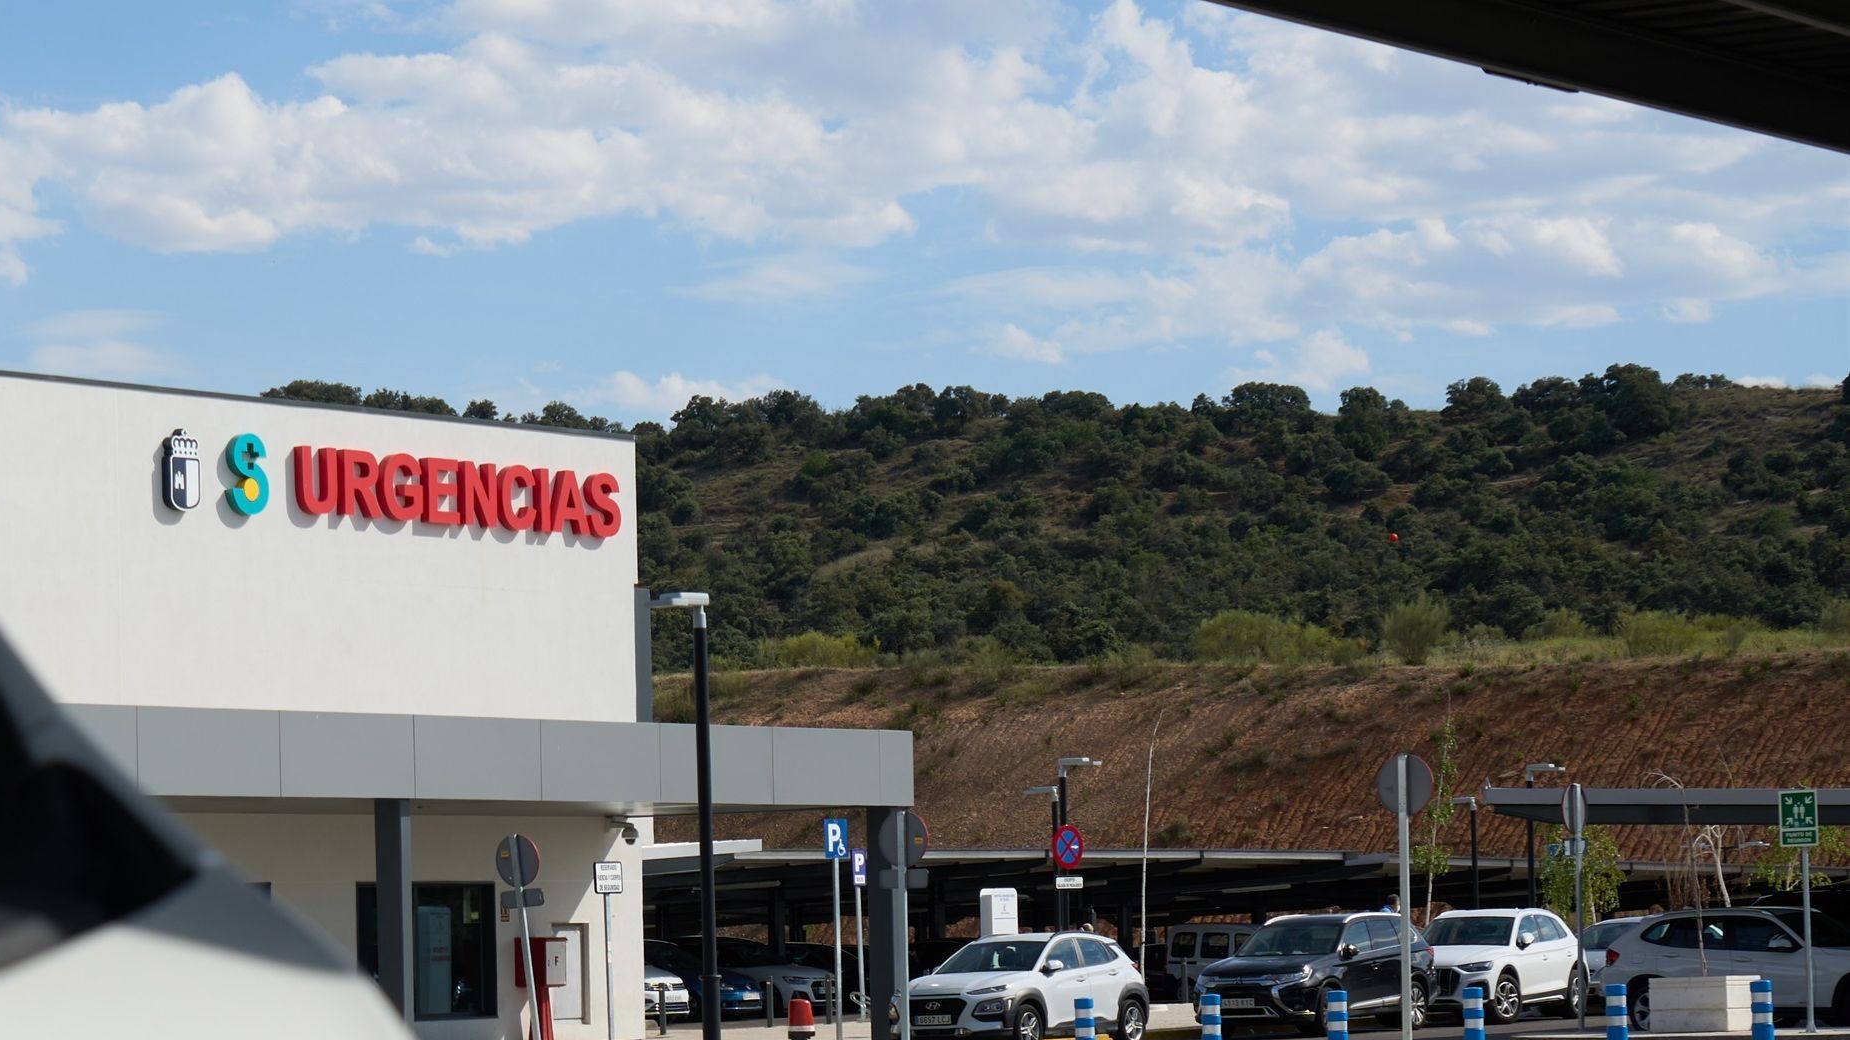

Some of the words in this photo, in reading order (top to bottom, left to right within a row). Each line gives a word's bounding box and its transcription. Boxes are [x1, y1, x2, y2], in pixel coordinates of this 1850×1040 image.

[294, 445, 622, 538] URGENCIAS
[828, 823, 841, 852] P
[854, 853, 865, 872] P
